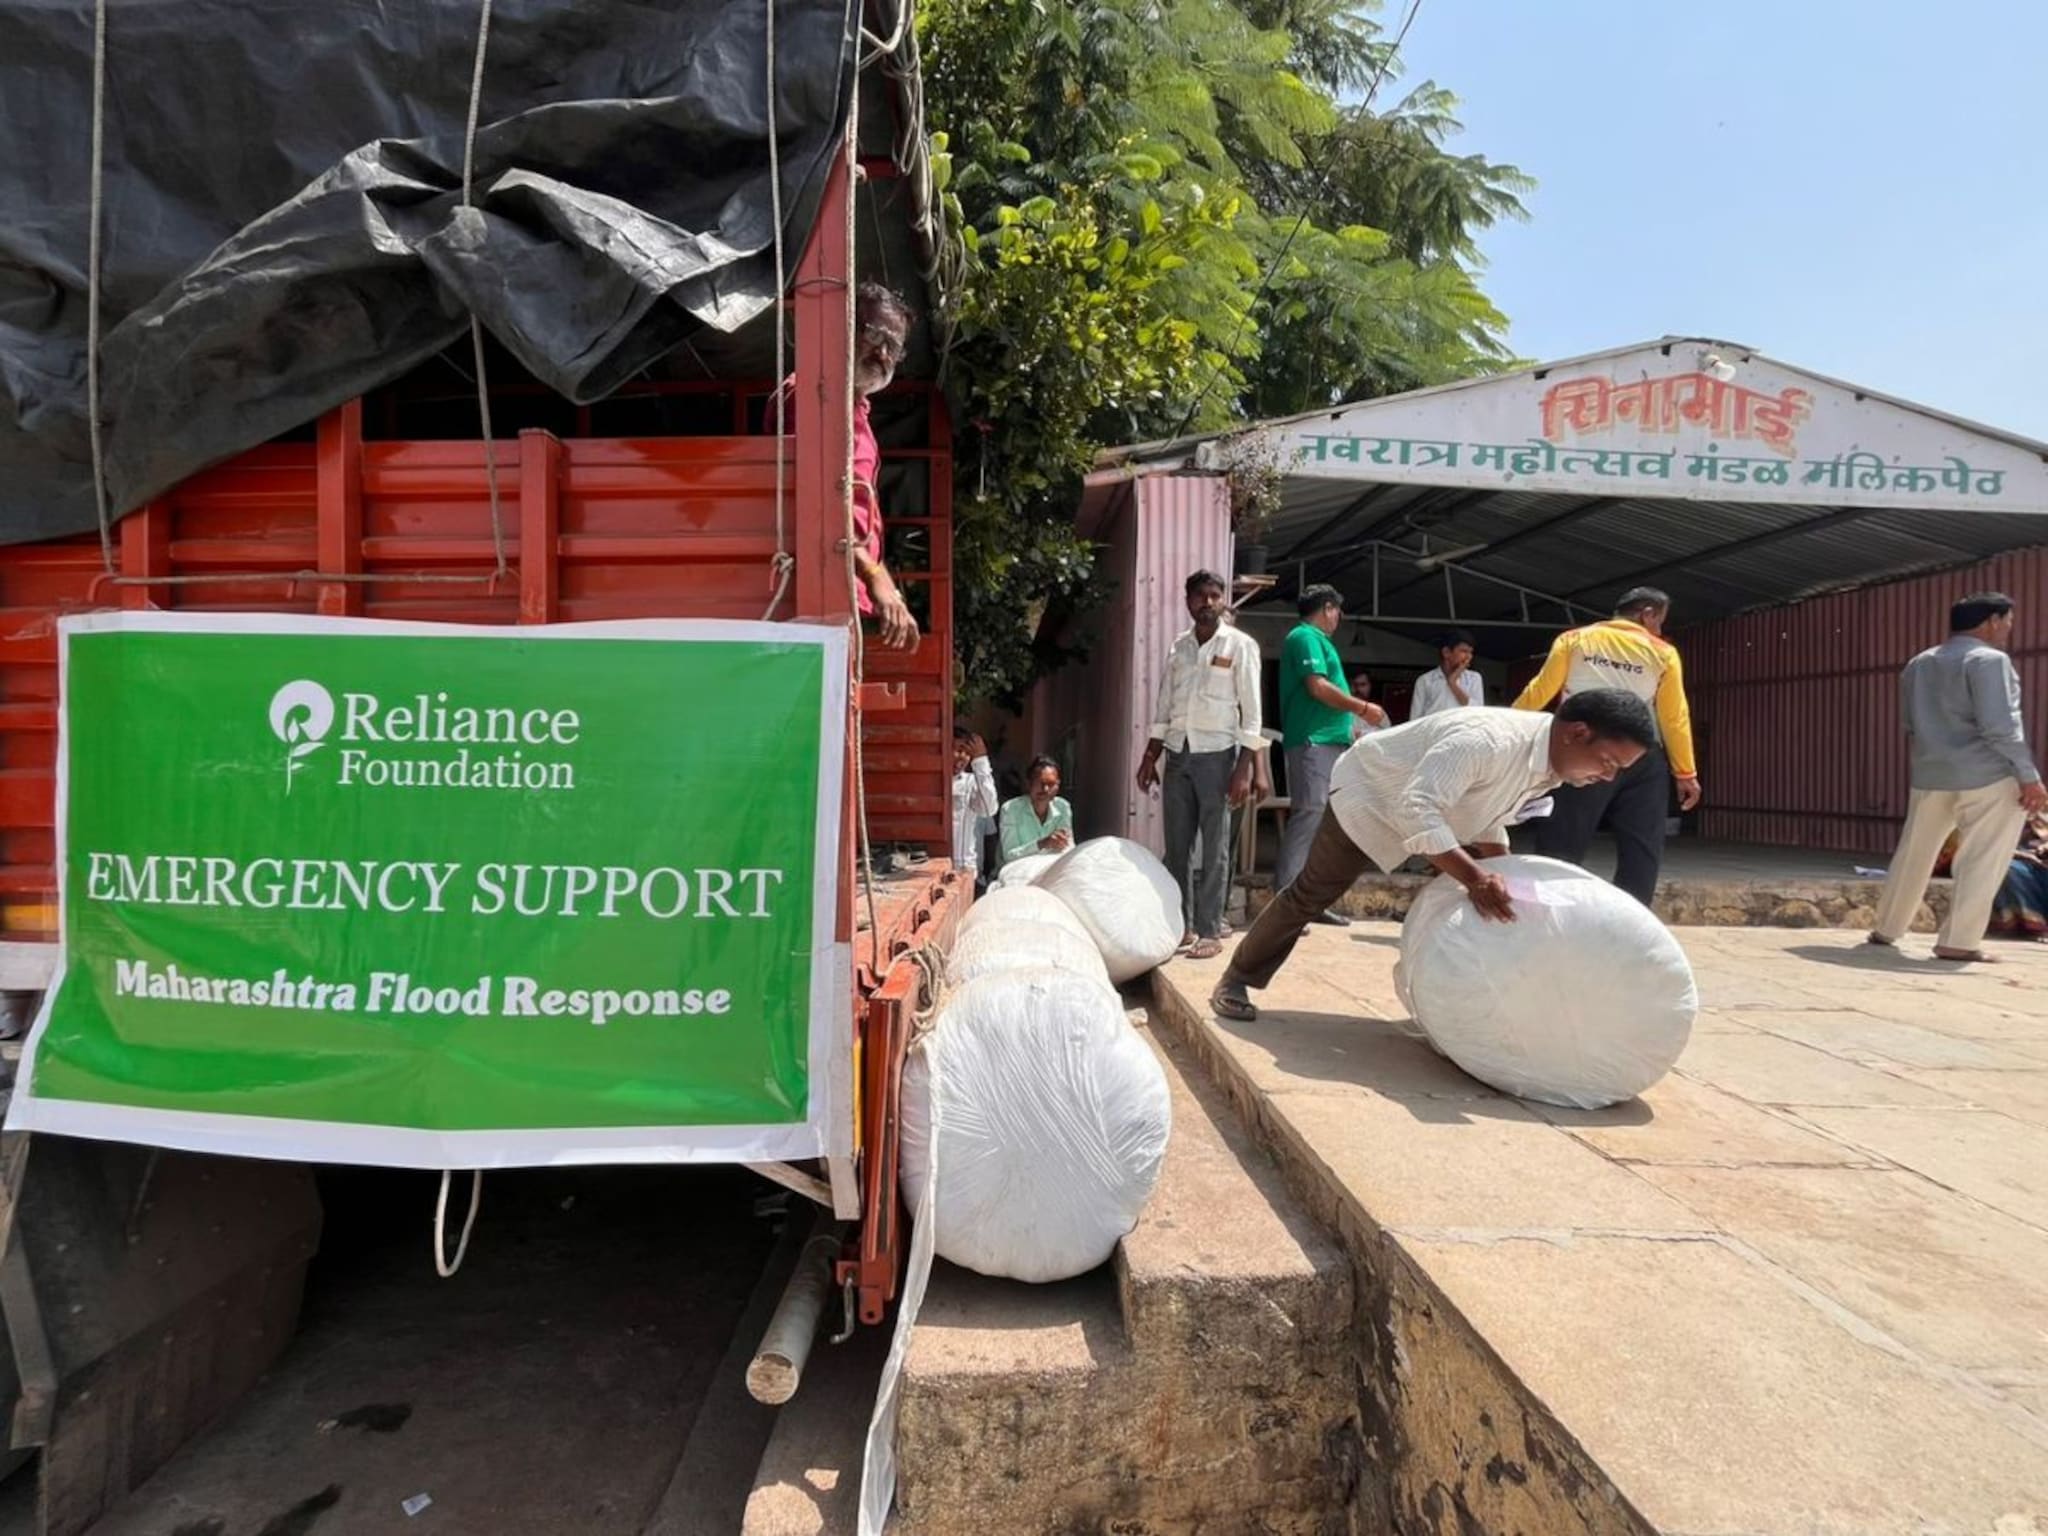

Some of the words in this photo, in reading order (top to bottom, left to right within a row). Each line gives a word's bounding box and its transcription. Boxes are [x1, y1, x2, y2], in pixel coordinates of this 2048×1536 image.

[1299, 434, 1462, 467] नवरात्र
[1468, 438, 1675, 477] महोत्सव
[1685, 443, 1791, 486] मंडळ
[341, 692, 580, 745] Reliance
[337, 749, 575, 790] Foundation
[87, 852, 461, 913] EMERGENCY
[471, 862, 783, 918] SUPPORT
[115, 958, 356, 1012] Maharashtra
[365, 971, 491, 1016] Flood
[501, 975, 732, 1025] Response
